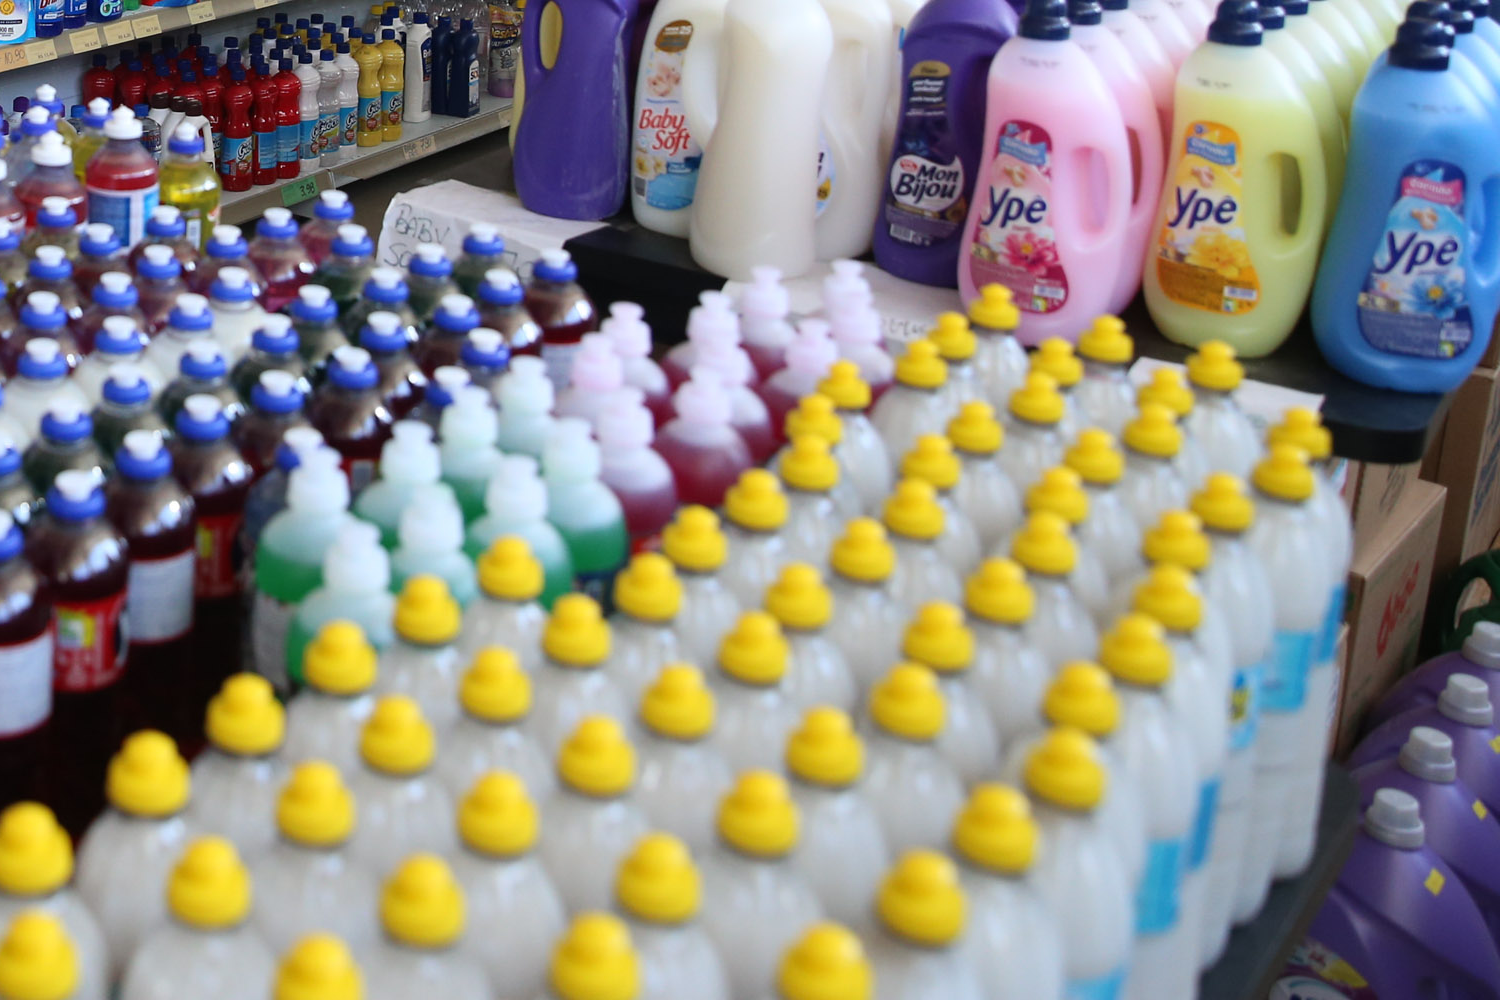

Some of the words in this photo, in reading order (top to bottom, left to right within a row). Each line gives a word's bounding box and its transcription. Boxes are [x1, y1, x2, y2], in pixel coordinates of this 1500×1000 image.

[639, 108, 685, 139] Baby
[654, 131, 691, 155] Soft
[896, 176, 958, 203] Bijou
[916, 165, 959, 184] Mon
[982, 186, 1048, 229] Ypê
[1167, 185, 1238, 229] Ypê
[1374, 230, 1459, 277] Ypê
